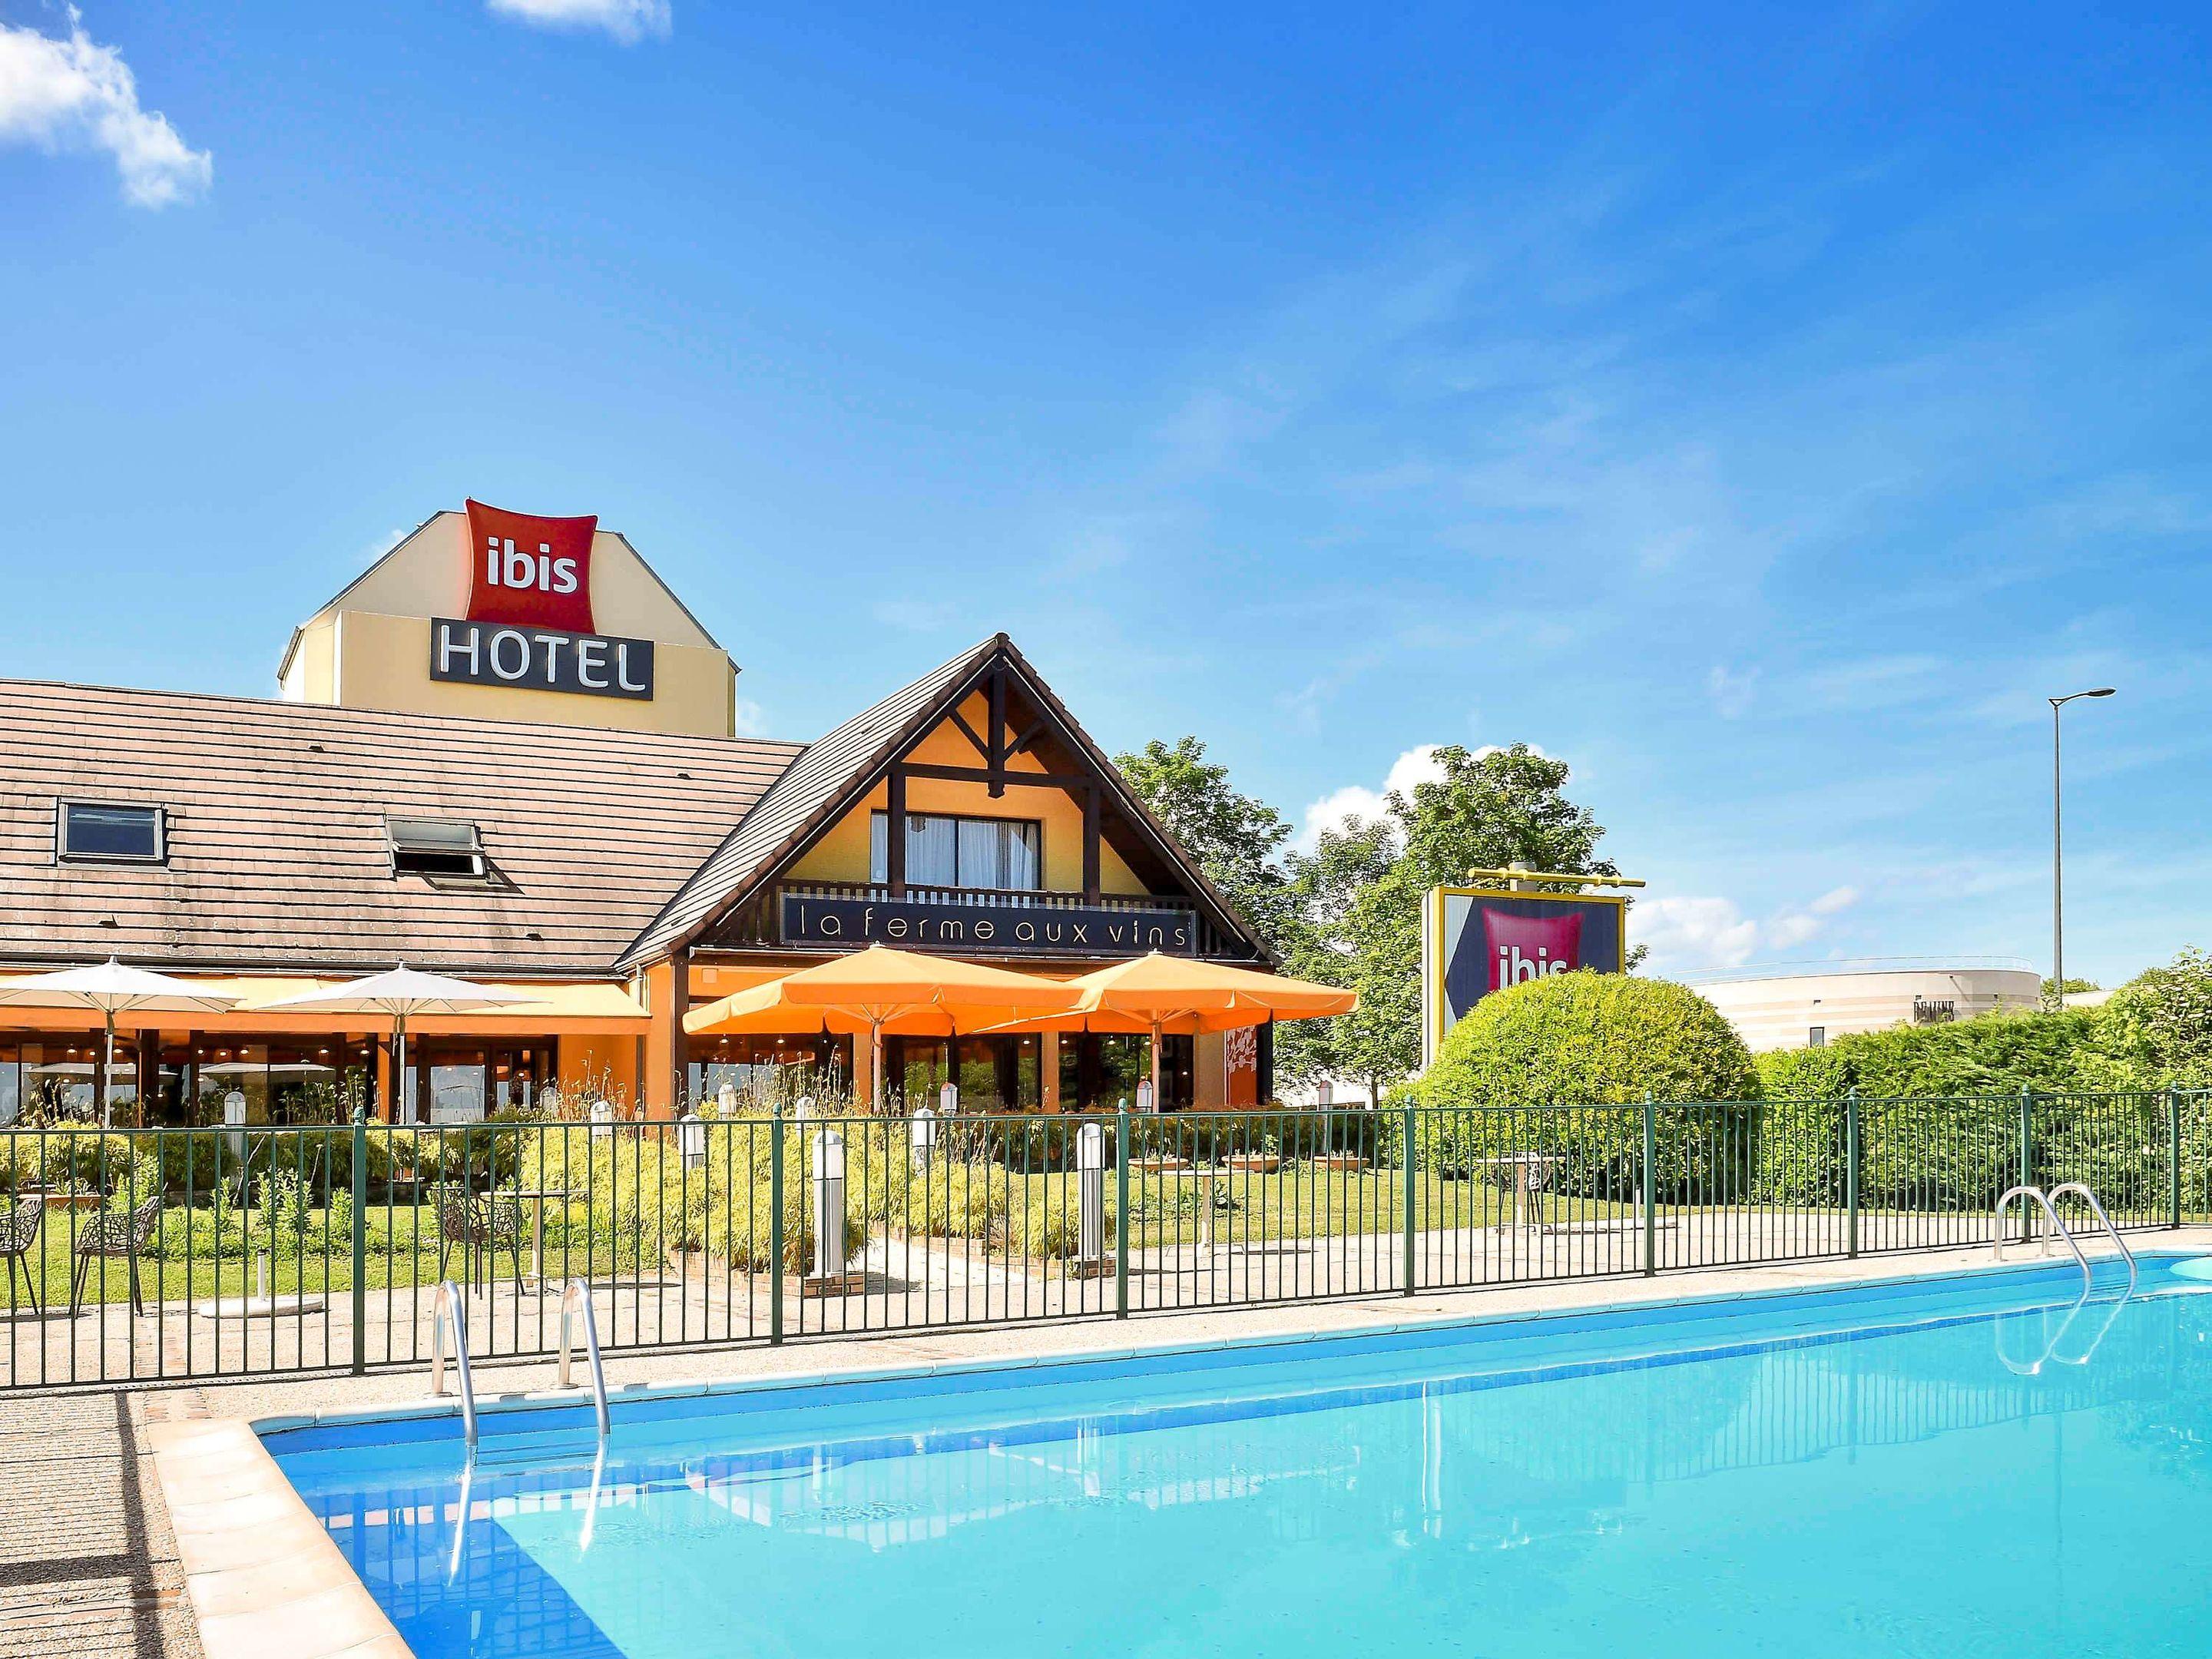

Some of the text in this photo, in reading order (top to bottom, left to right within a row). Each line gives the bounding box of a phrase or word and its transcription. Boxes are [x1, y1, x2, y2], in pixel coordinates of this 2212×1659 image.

[488, 537, 578, 593] ibis
[440, 624, 646, 691] HOTEL
[801, 905, 1185, 945] la ferme aux vins
